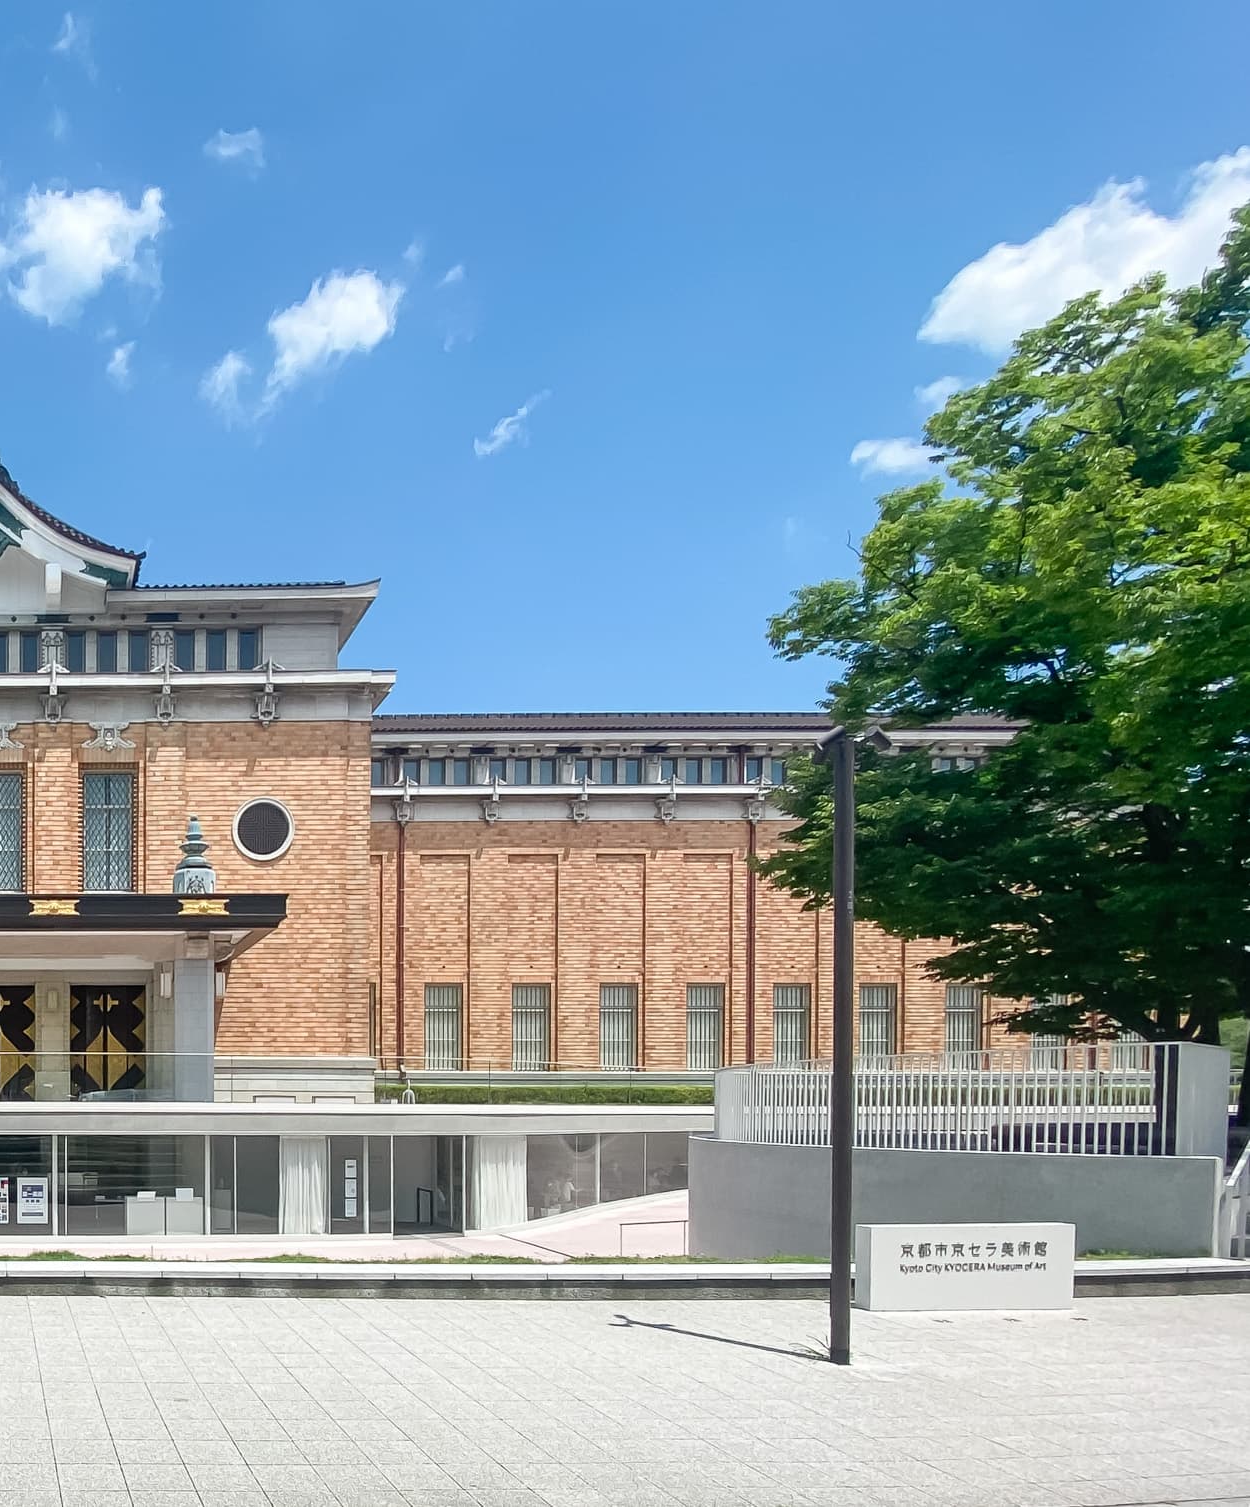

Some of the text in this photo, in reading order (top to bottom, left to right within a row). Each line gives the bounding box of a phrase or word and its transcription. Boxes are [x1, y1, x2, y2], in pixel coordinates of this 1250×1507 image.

[900, 1241, 1048, 1258] 京都市京セラ美術館
[900, 1262, 1047, 1275] Kyoto City KYOCERA Museum of Art
